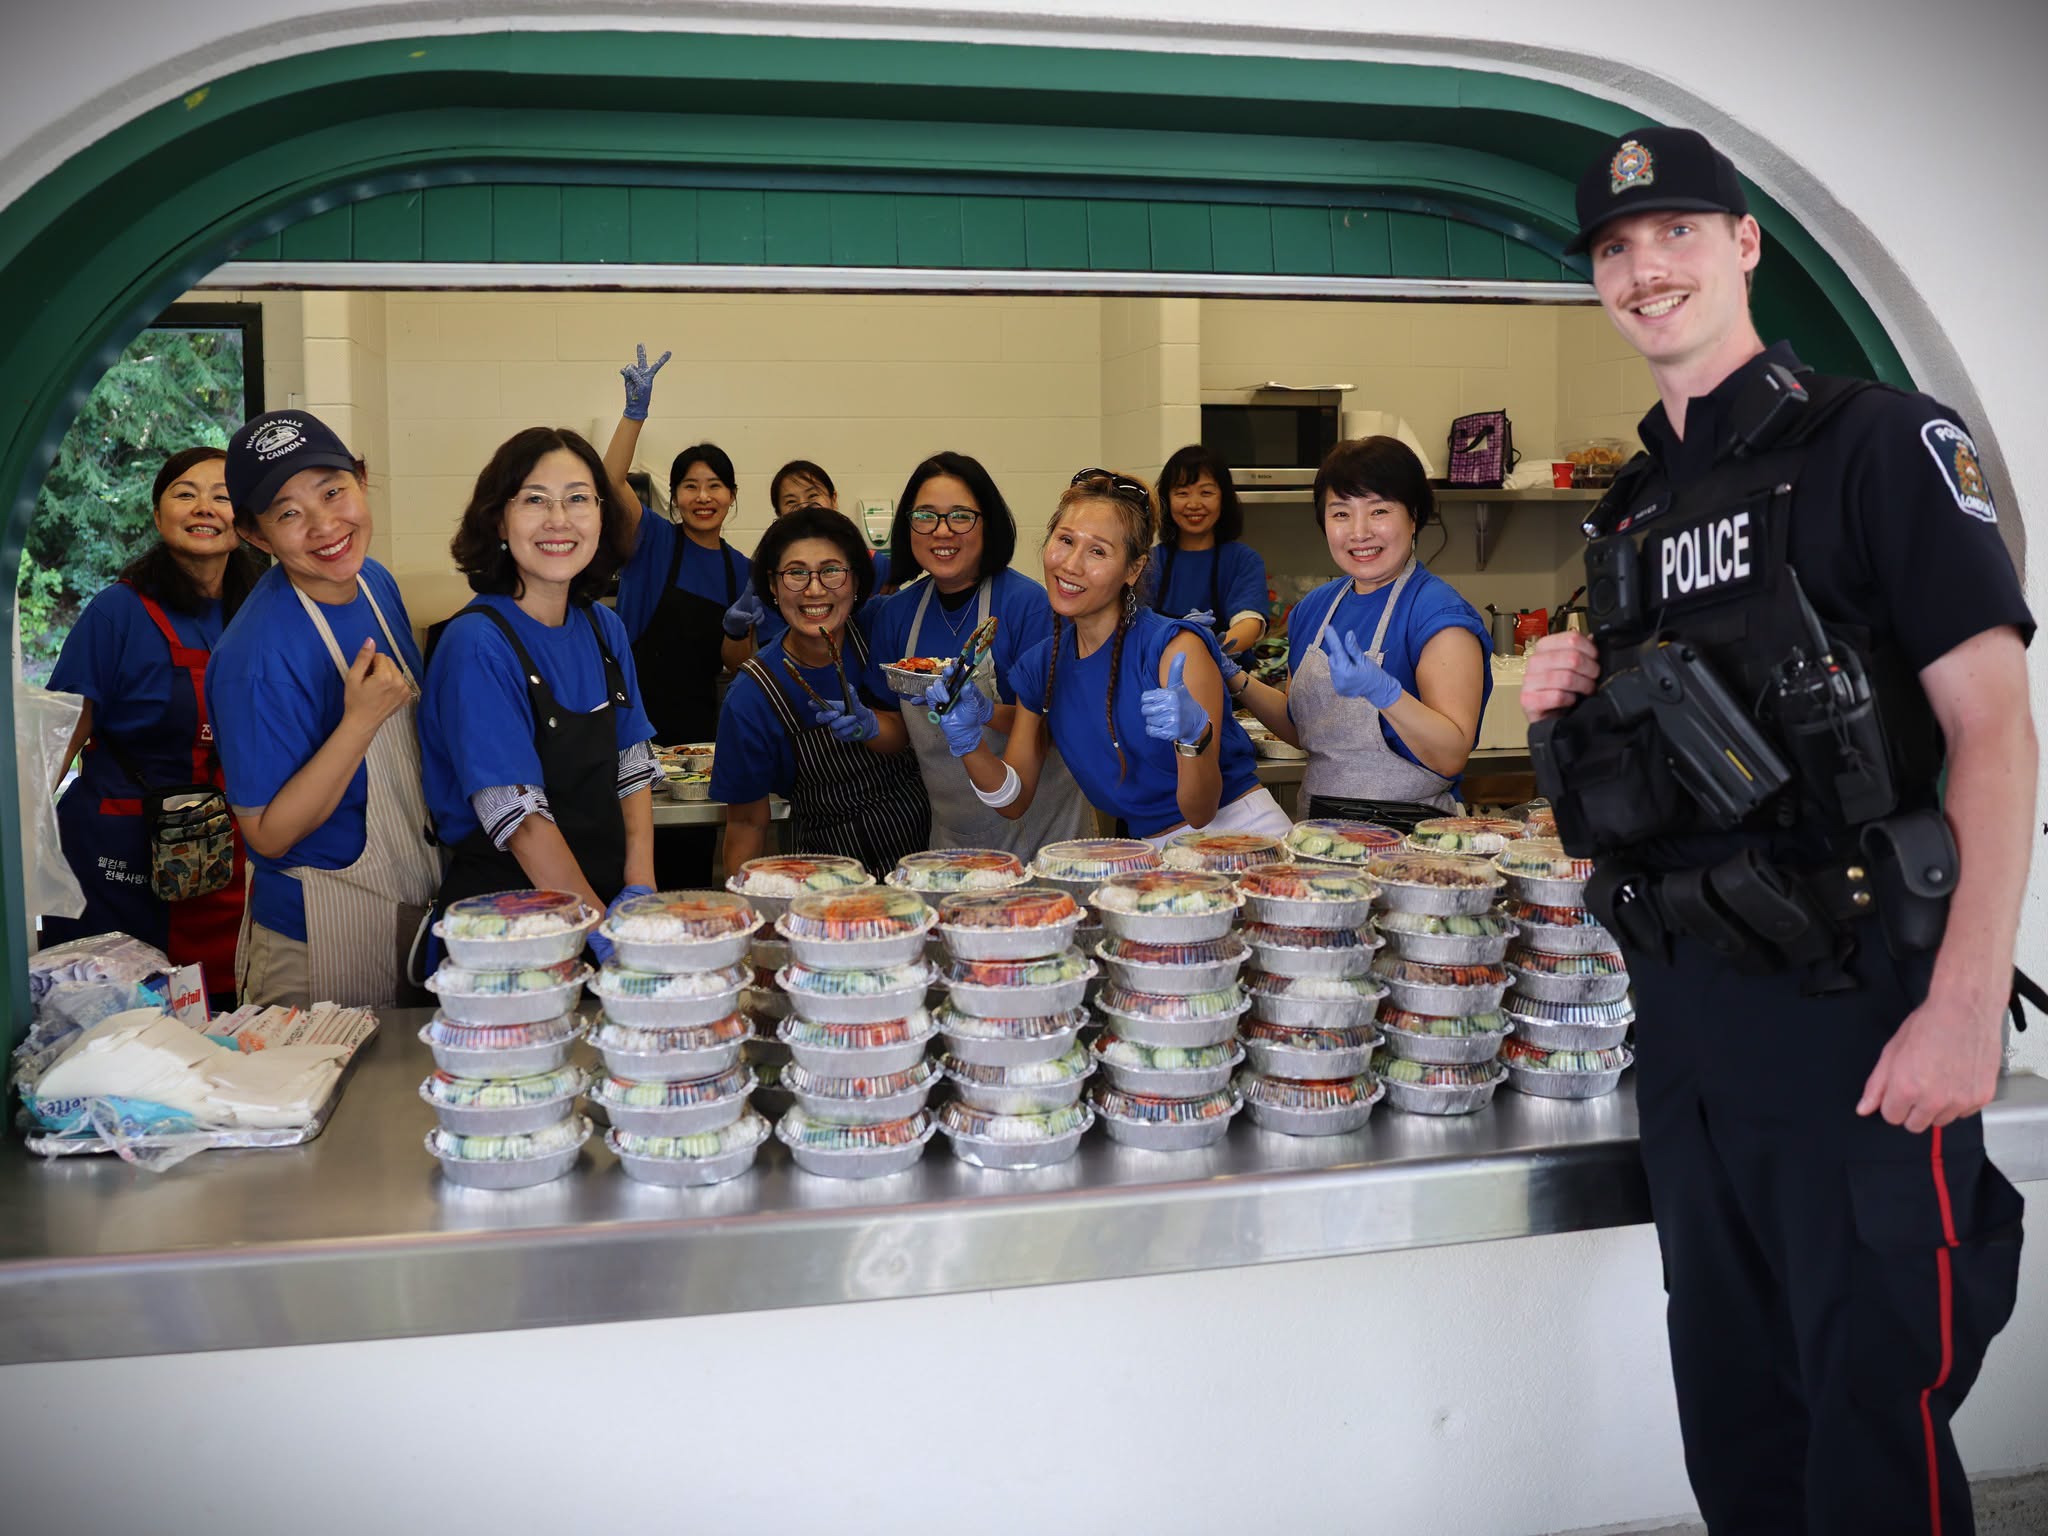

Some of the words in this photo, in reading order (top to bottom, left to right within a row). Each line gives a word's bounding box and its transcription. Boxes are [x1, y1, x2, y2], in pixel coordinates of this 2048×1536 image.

[246, 420, 276, 449] NIAGARA
[277, 419, 303, 428] FALLS
[266, 440, 303, 460] CANADA
[1662, 512, 1750, 600] POLICE
[105, 870, 148, 885] 전북사랑
